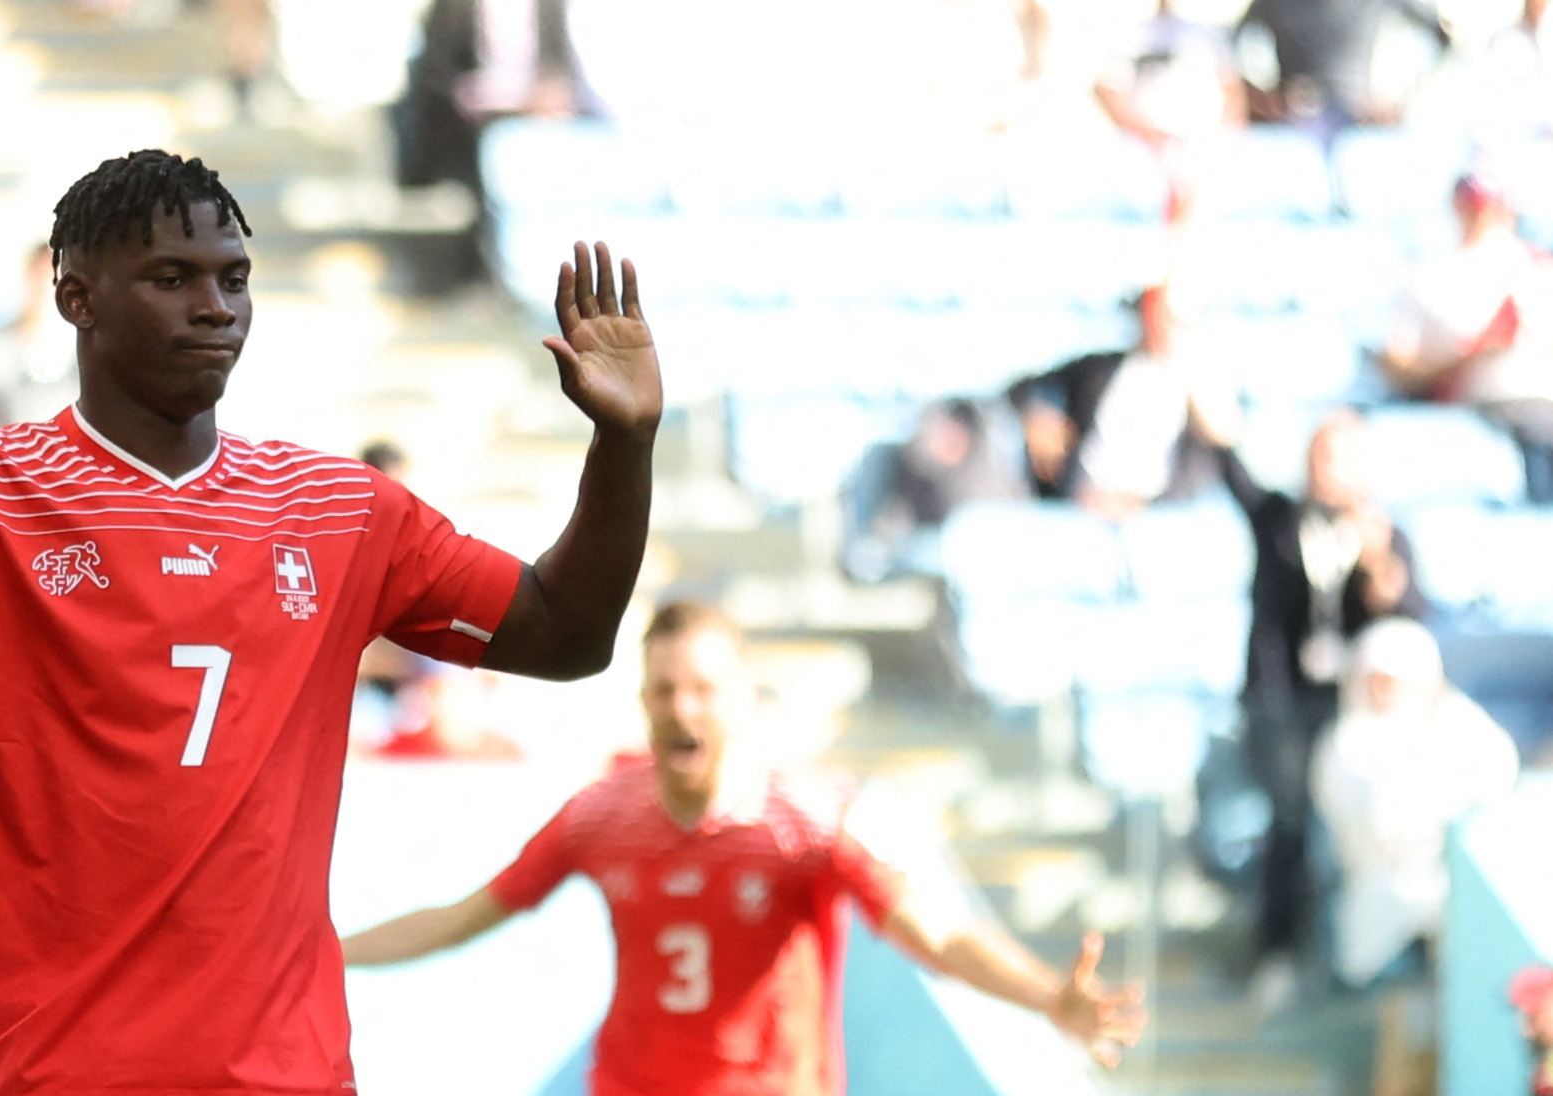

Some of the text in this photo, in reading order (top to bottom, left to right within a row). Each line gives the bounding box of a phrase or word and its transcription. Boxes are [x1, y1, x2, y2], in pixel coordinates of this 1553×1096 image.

[161, 556, 212, 577] PUMA
[170, 644, 233, 767] 7
[655, 921, 714, 1014] 3
